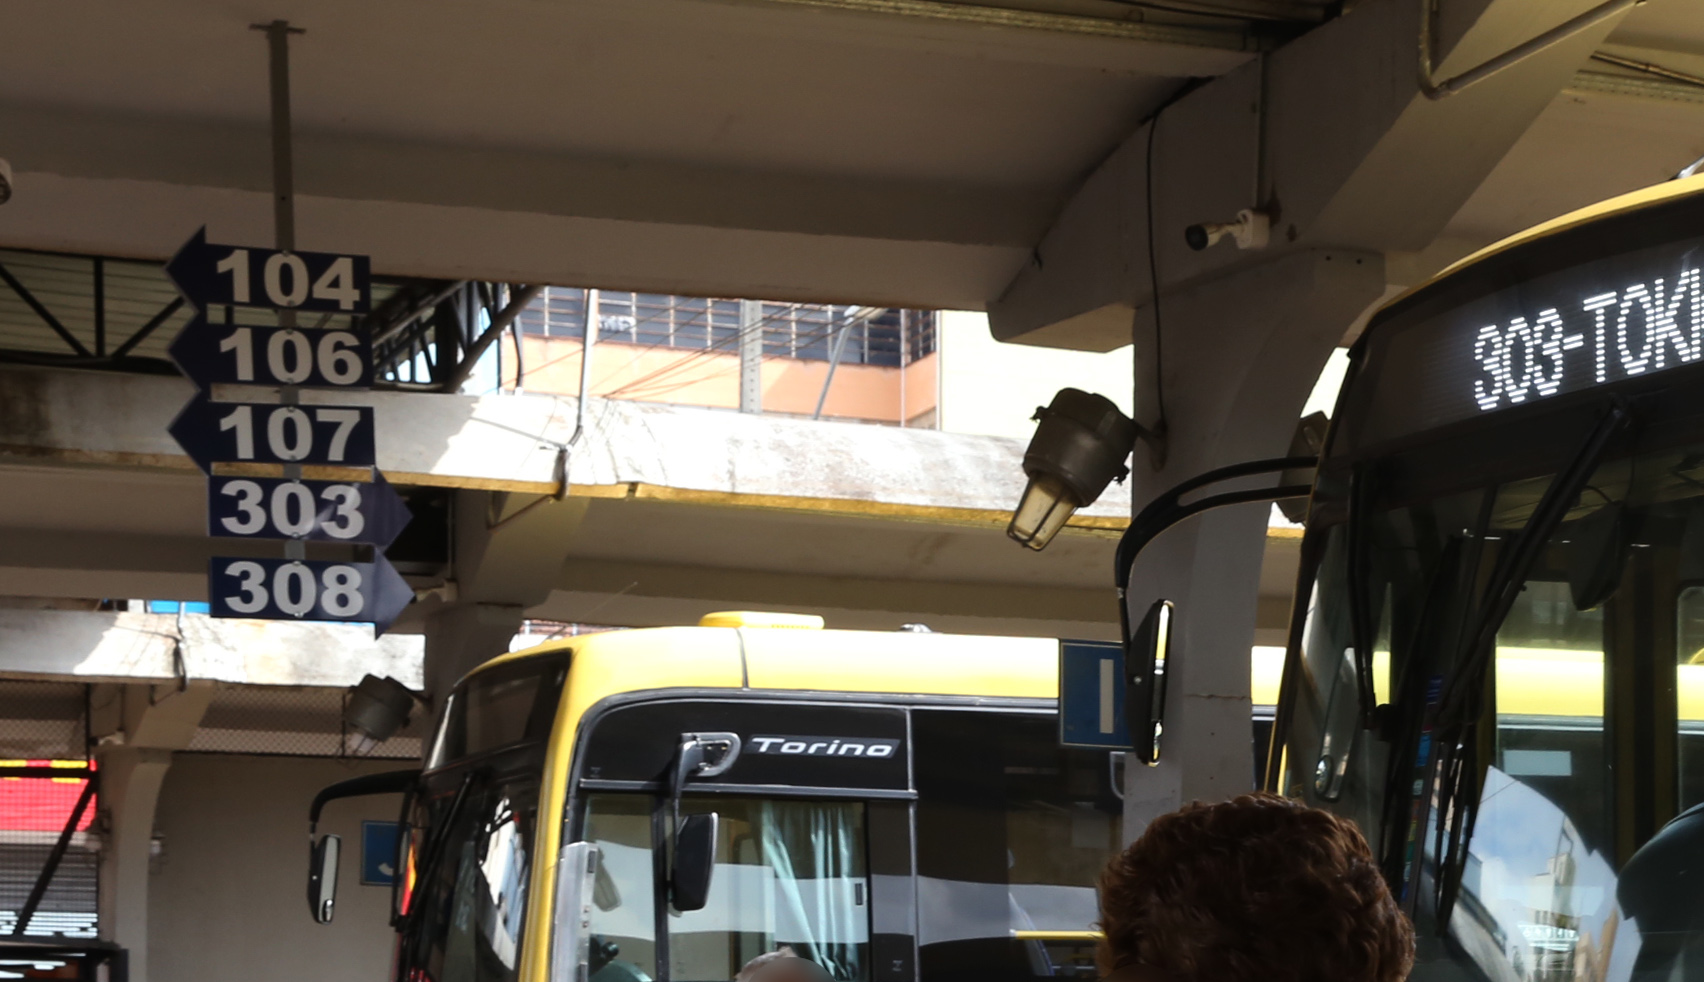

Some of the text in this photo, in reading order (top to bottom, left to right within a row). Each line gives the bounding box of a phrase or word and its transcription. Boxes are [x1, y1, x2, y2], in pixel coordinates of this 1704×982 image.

[216, 250, 360, 310] 104
[218, 327, 363, 385] 106
[219, 405, 361, 462] 107
[220, 480, 364, 539] 303
[224, 561, 364, 617] 308
[751, 737, 893, 757] Torino
